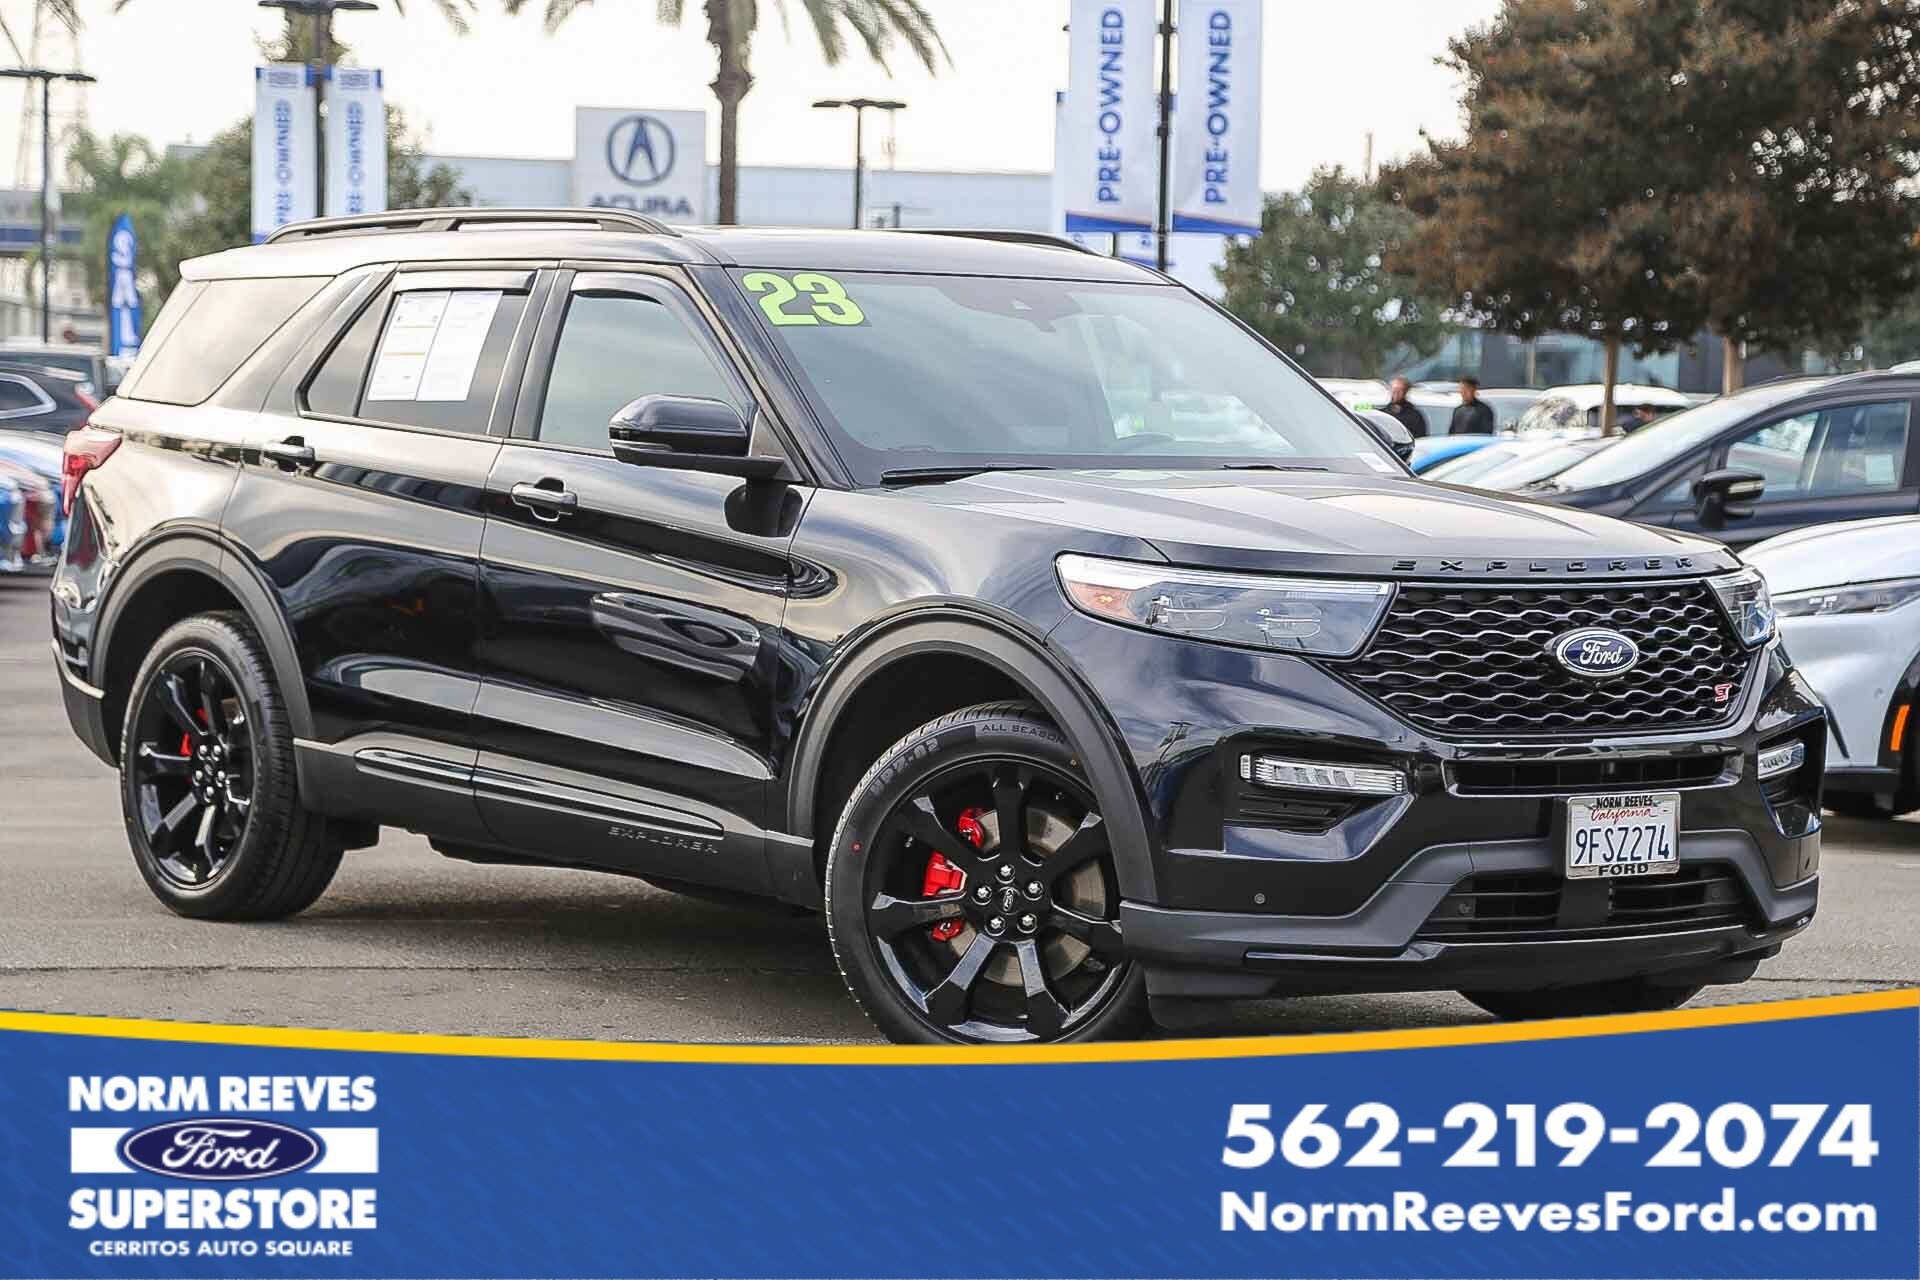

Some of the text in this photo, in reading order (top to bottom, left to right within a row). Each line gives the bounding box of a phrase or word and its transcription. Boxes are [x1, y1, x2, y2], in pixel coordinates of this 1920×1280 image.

[1097, 9, 1124, 203] PRE-OWNED
[1204, 10, 1232, 204] PRE-OWNED
[346, 101, 365, 214] RE-OWNED
[742, 271, 865, 327] 23
[1392, 557, 1694, 573] EXPLORER
[1579, 639, 1624, 666] Ford
[982, 723, 1067, 745] ALL SEASON
[1591, 807, 1654, 825] California
[1596, 795, 1653, 809] NORM REEVES
[608, 826, 720, 855] EXPLORER
[1574, 824, 1670, 865] 9FSZ274
[1598, 862, 1649, 876] FORD
